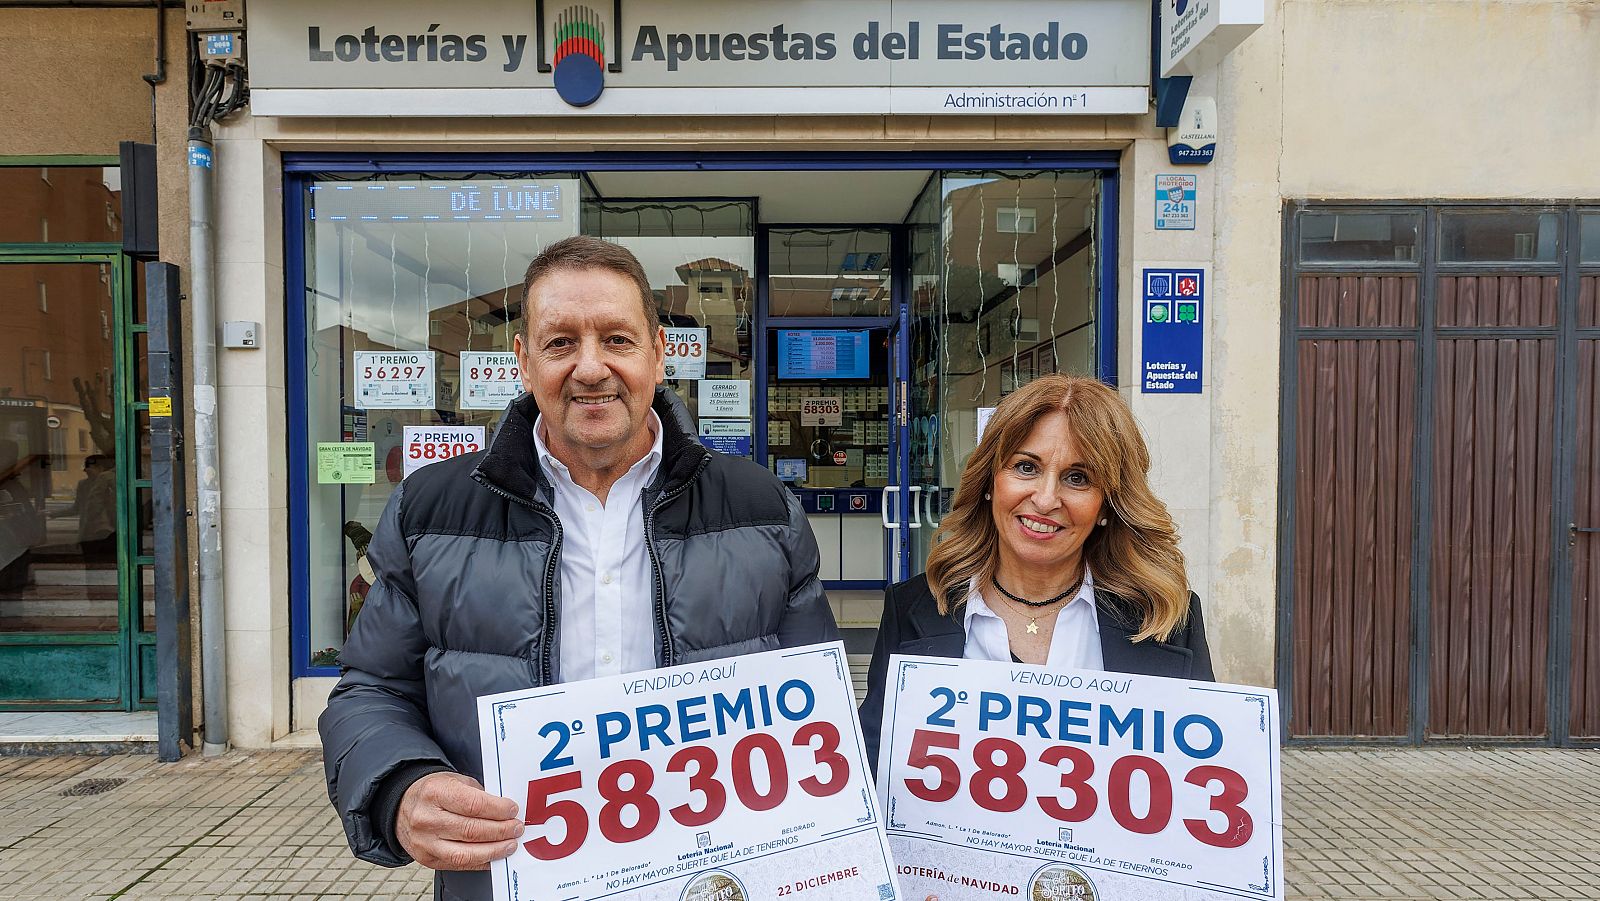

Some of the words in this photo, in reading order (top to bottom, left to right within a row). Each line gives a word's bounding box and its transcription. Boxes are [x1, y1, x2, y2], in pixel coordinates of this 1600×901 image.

[308, 23, 487, 62] Loterías
[502, 34, 528, 73] y
[631, 24, 837, 71] Apuestas
[853, 21, 920, 61] del
[936, 21, 1088, 61] Estado
[1171, 36, 1190, 59] Estado
[943, 92, 1058, 107] Administración
[1080, 93, 1087, 107] 1
[451, 191, 481, 211] DE
[666, 334, 698, 342] EMIO
[665, 343, 701, 357] 303
[380, 356, 418, 364] PREMIO
[487, 356, 516, 365] PREMI
[1146, 362, 1179, 370] Loterías
[1181, 363, 1187, 372] y
[364, 367, 426, 379] 56297
[470, 367, 519, 380] 8929
[1146, 371, 1184, 381] Apuestas
[1185, 371, 1198, 380] del
[1146, 381, 1175, 389] Estado
[804, 405, 839, 414] 58303
[425, 433, 475, 442] PREMIO
[622, 672, 694, 695] VENDIDO
[699, 662, 737, 687] AQUÍ
[1010, 669, 1083, 689] VENDIDO
[1087, 678, 1132, 694] AQUÍ
[596, 679, 815, 759] PREMIO
[978, 691, 1224, 759] PREMIO
[522, 721, 850, 861] 58303
[903, 728, 1254, 849] 58303
[781, 822, 815, 835] BELORADO
[925, 820, 947, 829] Admon.
[678, 850, 703, 861] Lotería
[704, 842, 733, 854] Nacional
[1064, 842, 1095, 854] Nacional
[606, 881, 620, 891] NO
[622, 874, 641, 886] HAY
[642, 868, 674, 883] MAYOR
[676, 857, 708, 872] SUERTE
[711, 853, 728, 863] QUE
[730, 848, 740, 859] LA
[743, 845, 754, 856] DE
[756, 835, 798, 852] TENERNOS
[966, 836, 979, 846] NO
[980, 838, 998, 849] HAY
[1000, 842, 1032, 853] MAYOR
[1033, 845, 1066, 859] SUERTE
[1068, 852, 1087, 862] QUE
[1089, 855, 1101, 865] LA
[1103, 857, 1116, 867] DE
[1118, 861, 1168, 877] TENERNOS
[1150, 857, 1193, 870] BELORADO
[557, 880, 582, 890] Admon.
[777, 886, 791, 897] 22
[796, 867, 859, 892] DICIEMBRE
[897, 865, 945, 881] LOTERÍA
[947, 875, 960, 884] de
[961, 876, 1019, 895] NAVIDAD
